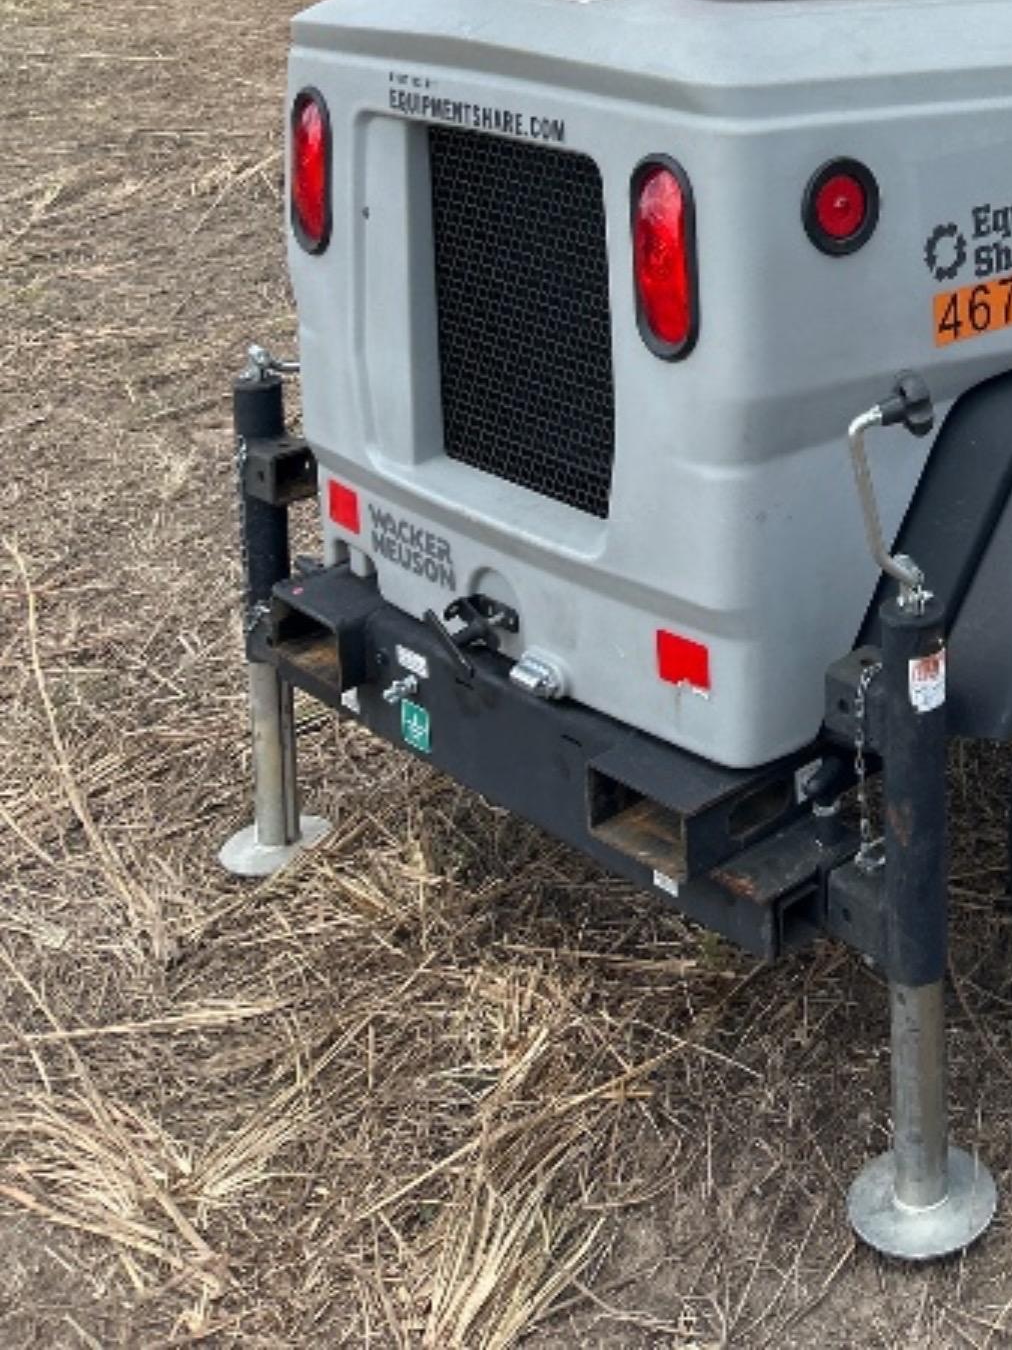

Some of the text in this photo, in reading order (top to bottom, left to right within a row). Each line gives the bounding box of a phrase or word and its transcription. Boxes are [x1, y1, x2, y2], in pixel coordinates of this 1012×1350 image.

[388, 87, 566, 142] EQUIPMENTSHARE.COM
[368, 503, 453, 565] WACKER
[371, 530, 457, 592] NEUSON
